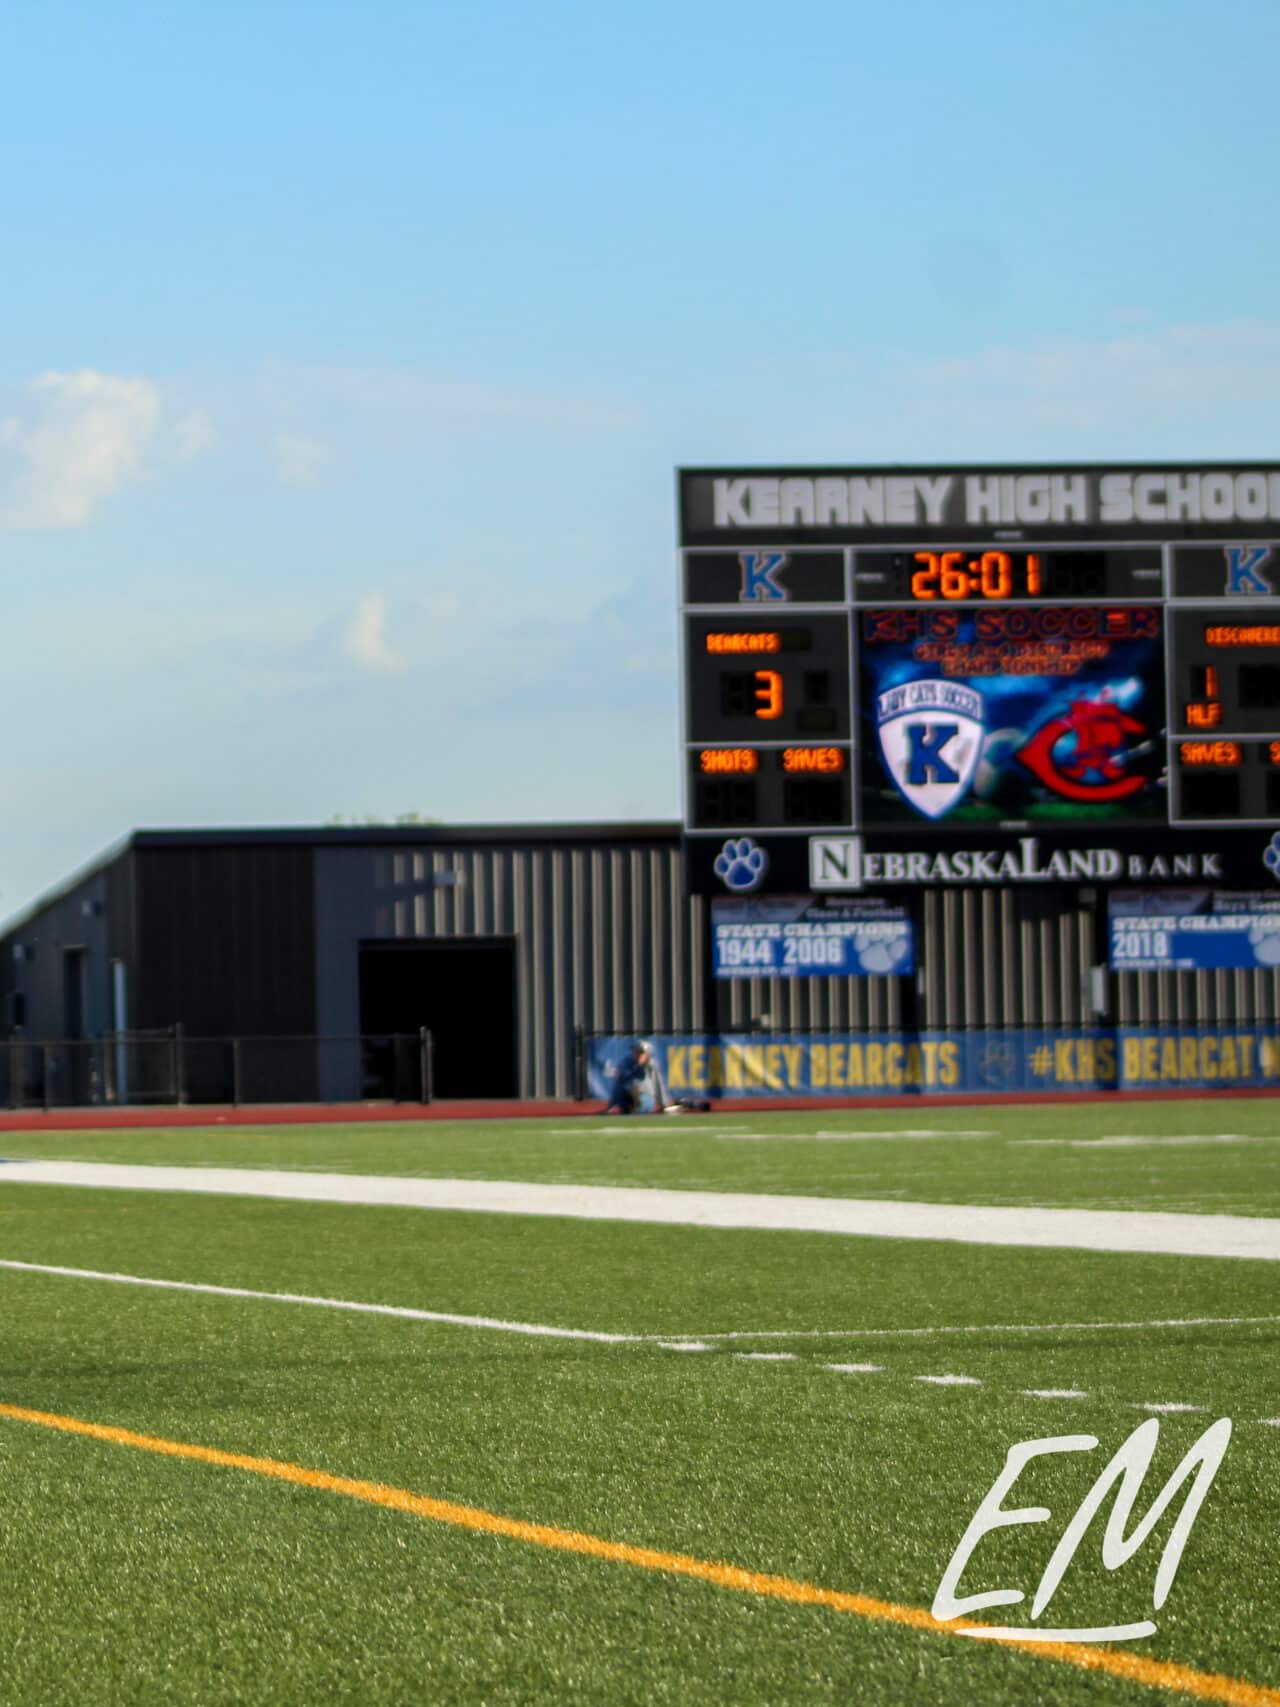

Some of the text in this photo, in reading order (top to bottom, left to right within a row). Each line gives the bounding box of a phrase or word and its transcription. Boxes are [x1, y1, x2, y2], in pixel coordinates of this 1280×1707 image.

[714, 476, 951, 526] KEARNEY
[965, 474, 1087, 524] HIGH
[738, 551, 787, 600] K
[911, 551, 1040, 598] 26:01
[1224, 546, 1270, 595] K
[865, 607, 1158, 641] KHS SOCCER
[754, 670, 784, 719] 3
[1186, 703, 1221, 728] HLF
[700, 748, 758, 774] SHOTS
[783, 747, 843, 773] SAVES
[906, 723, 961, 785] K
[1180, 741, 1242, 766] SAVES
[1128, 853, 1220, 877] BANK
[716, 921, 908, 937] STATE CHAMPIONS
[1113, 916, 1177, 931] STATE
[716, 937, 843, 966] 1944 2006
[1111, 931, 1170, 958] 2018
[666, 1041, 959, 1090] KEARNEY BEARCATS
[1028, 1038, 1116, 1083] #KHS
[1123, 1035, 1254, 1081] BEARCAT
